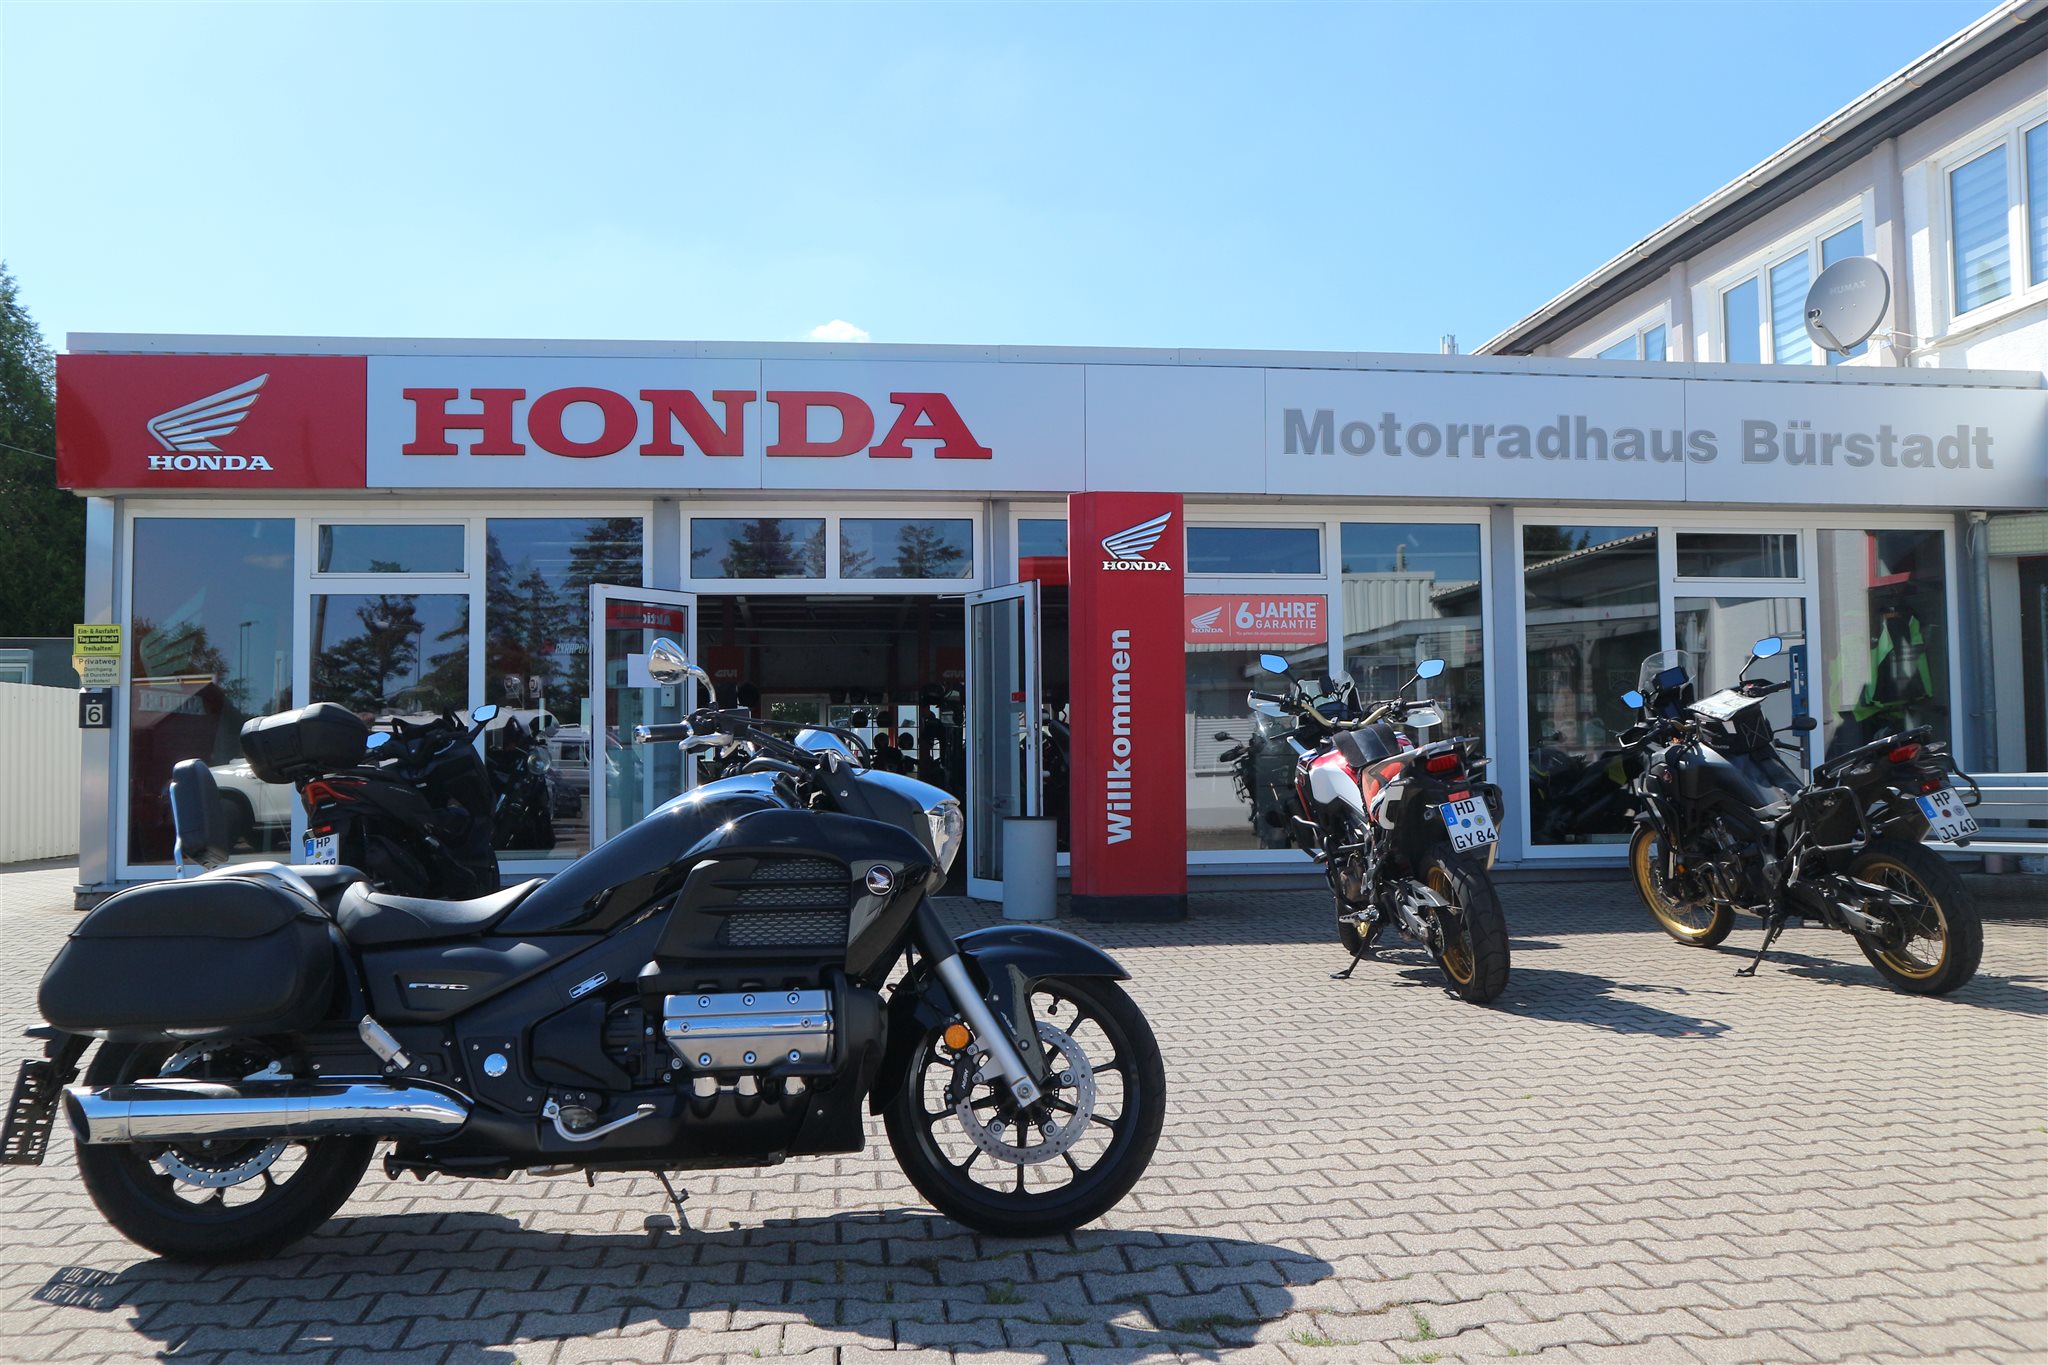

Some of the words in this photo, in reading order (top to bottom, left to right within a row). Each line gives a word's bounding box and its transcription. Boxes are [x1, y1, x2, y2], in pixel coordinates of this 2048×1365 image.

[402, 387, 993, 459] HONDA
[1283, 408, 1719, 464] Motorradhaus
[1741, 419, 1996, 470] Bürstadt
[147, 454, 274, 471] HONDA
[1102, 560, 1172, 571] HONDA
[1235, 602, 1255, 629] 6
[1255, 620, 1317, 629] GARANTIE
[78, 658, 117, 666] Privatweg
[88, 706, 101, 722] 6
[1106, 629, 1132, 845] Willkommen
[1931, 791, 1950, 807] HP
[1454, 800, 1475, 815] HD
[1940, 824, 1959, 840] JJ
[1960, 818, 1977, 833] 40
[316, 836, 331, 848] HP
[1454, 833, 1474, 849] GY
[1476, 827, 1496, 843] 84
